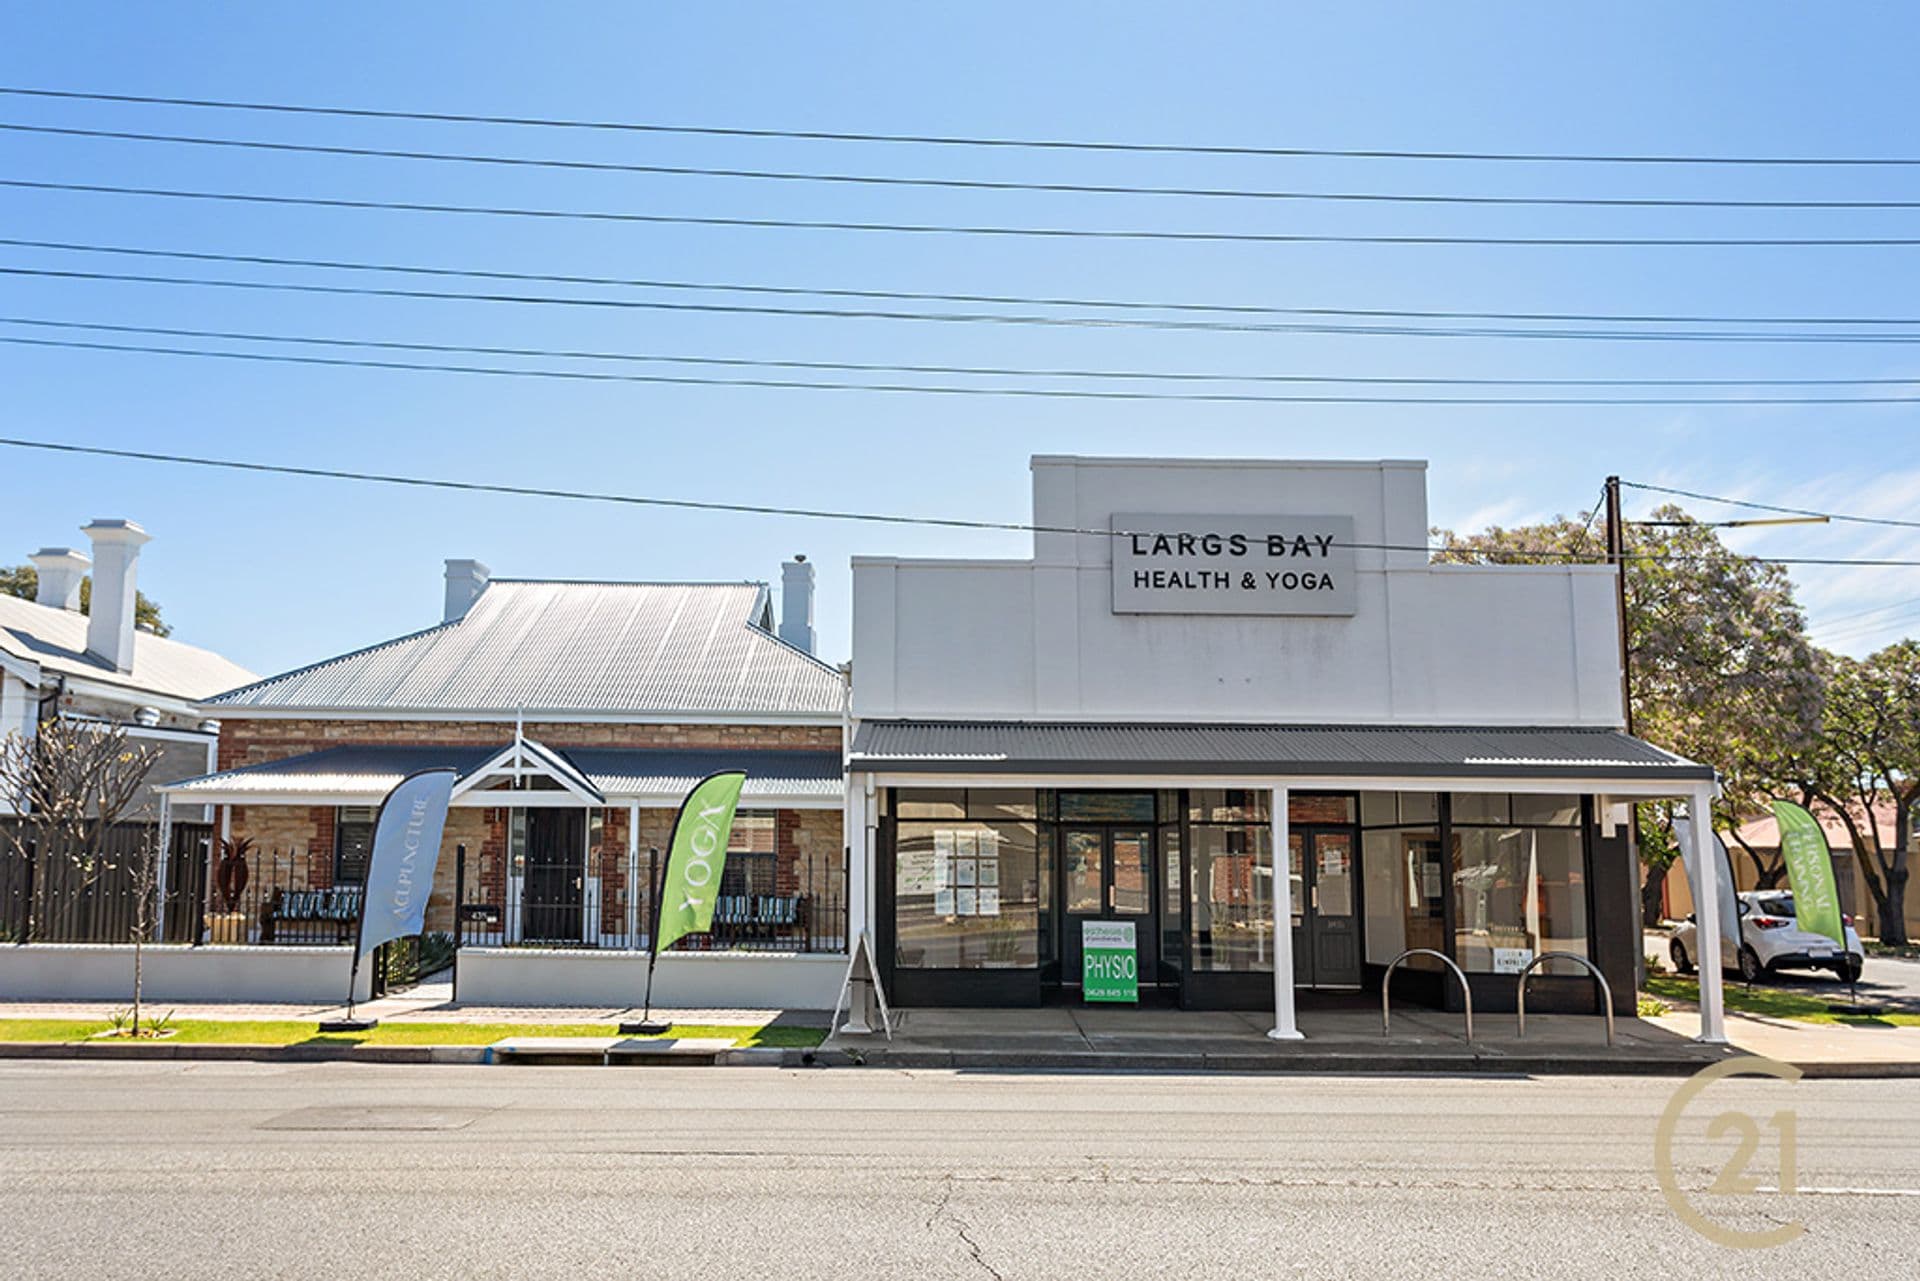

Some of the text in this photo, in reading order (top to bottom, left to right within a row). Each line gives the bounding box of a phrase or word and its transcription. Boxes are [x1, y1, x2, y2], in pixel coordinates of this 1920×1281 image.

[1131, 534, 1334, 558] LARGS BAY
[1133, 571, 1335, 590] HEALTH & YOGA
[679, 799, 726, 912] YOGA
[1084, 954, 1136, 979] PHYSIO
